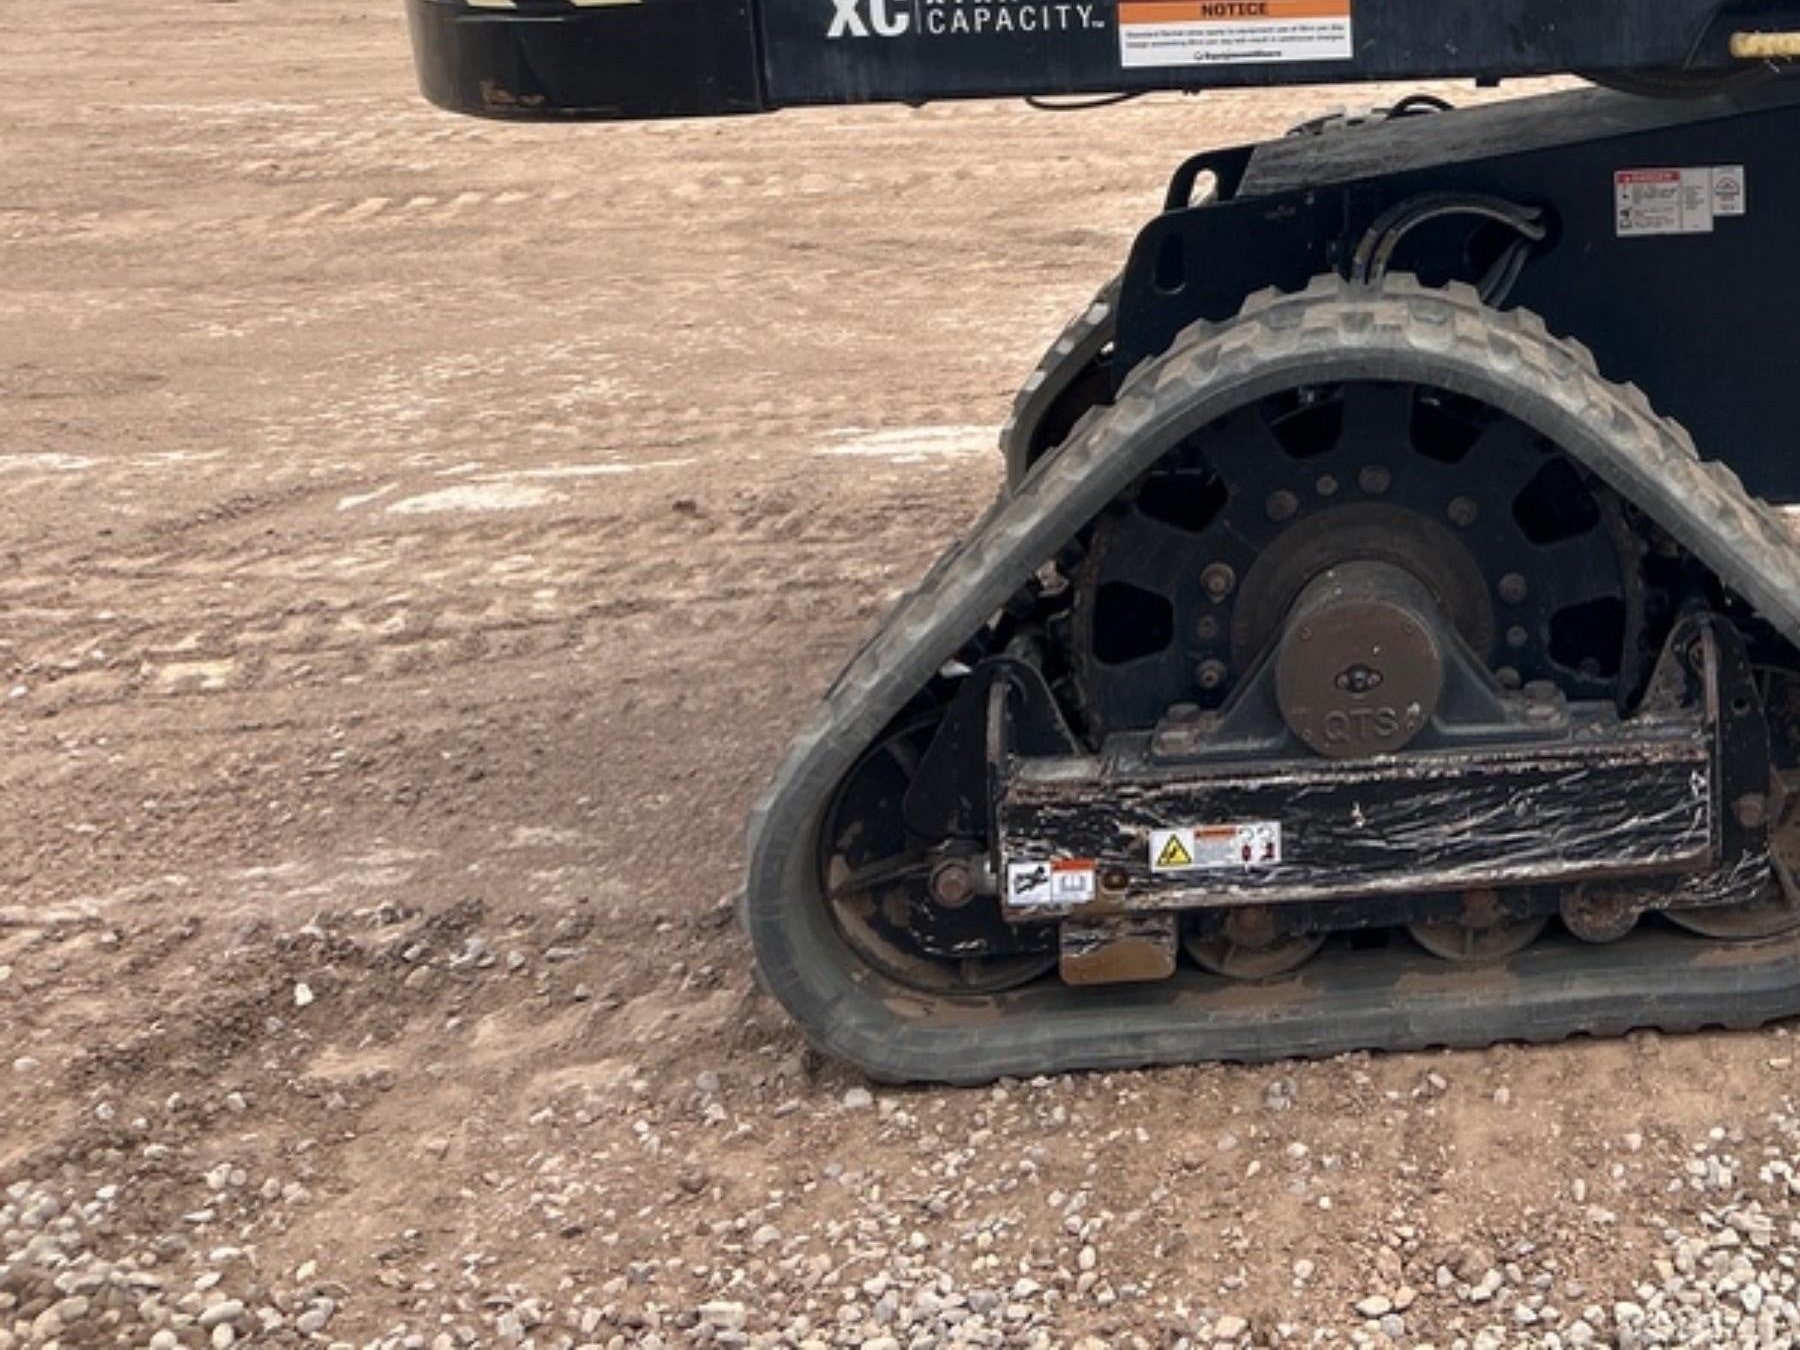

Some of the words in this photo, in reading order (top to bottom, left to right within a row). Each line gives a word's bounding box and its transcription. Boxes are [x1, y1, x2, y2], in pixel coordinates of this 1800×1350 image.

[927, 5, 1094, 35] CAPACITY
[1200, 1, 1269, 18] NOTICE
[1322, 707, 1399, 742] QTS
